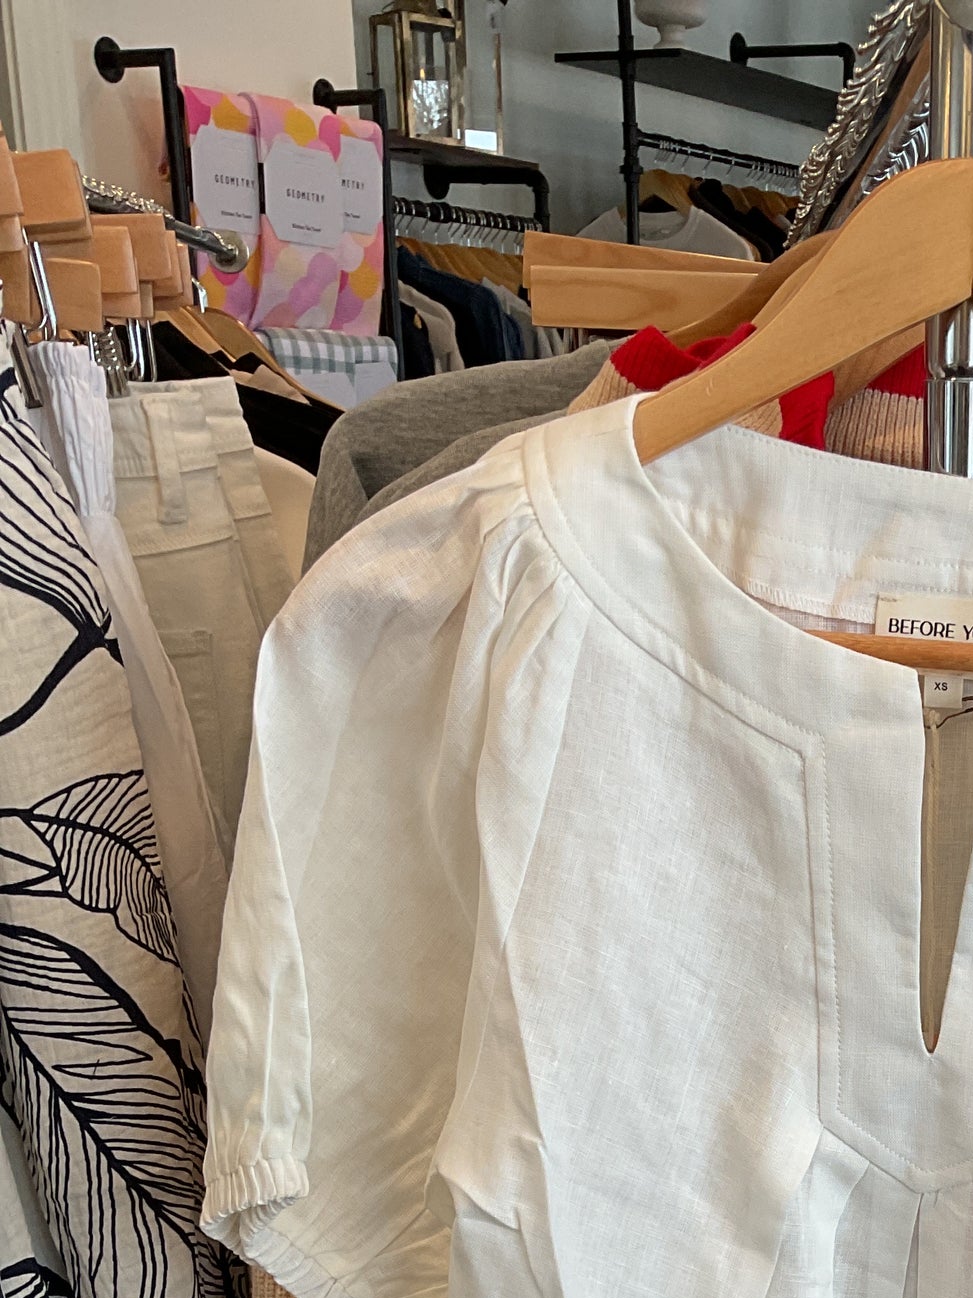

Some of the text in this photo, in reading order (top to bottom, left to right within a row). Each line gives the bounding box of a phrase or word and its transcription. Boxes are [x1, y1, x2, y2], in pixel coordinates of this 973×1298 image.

[214, 174, 256, 189] GEOMETRY
[341, 178, 365, 190] METRY
[286, 188, 325, 203] GEOMETRY
[888, 617, 956, 639] BEFORE
[934, 682, 948, 691] XS
